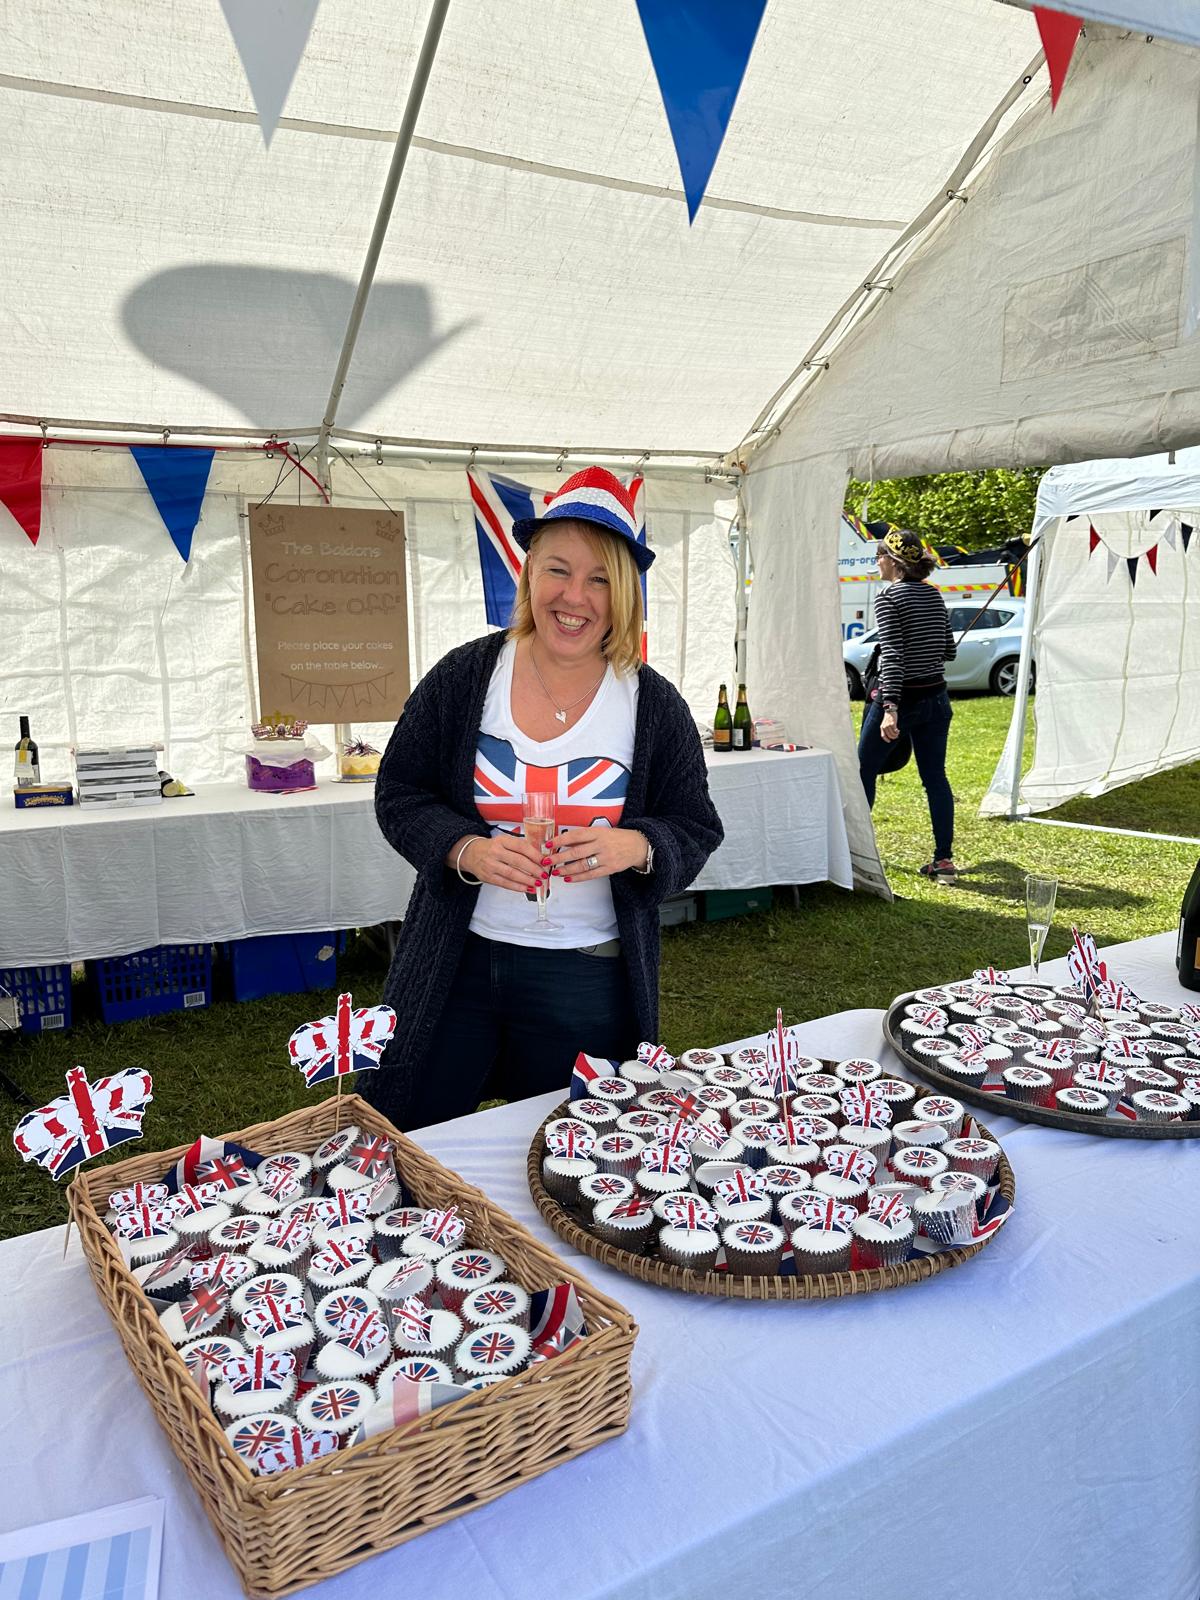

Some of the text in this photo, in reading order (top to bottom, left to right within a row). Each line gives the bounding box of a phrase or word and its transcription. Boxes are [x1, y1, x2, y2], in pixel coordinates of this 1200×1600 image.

[281, 541, 382, 558] The Baldons
[265, 563, 399, 585] Coronation
[278, 640, 393, 652] Please place your cakes
[290, 662, 304, 671] on
[305, 661, 322, 670] the
[323, 661, 348, 670] table
